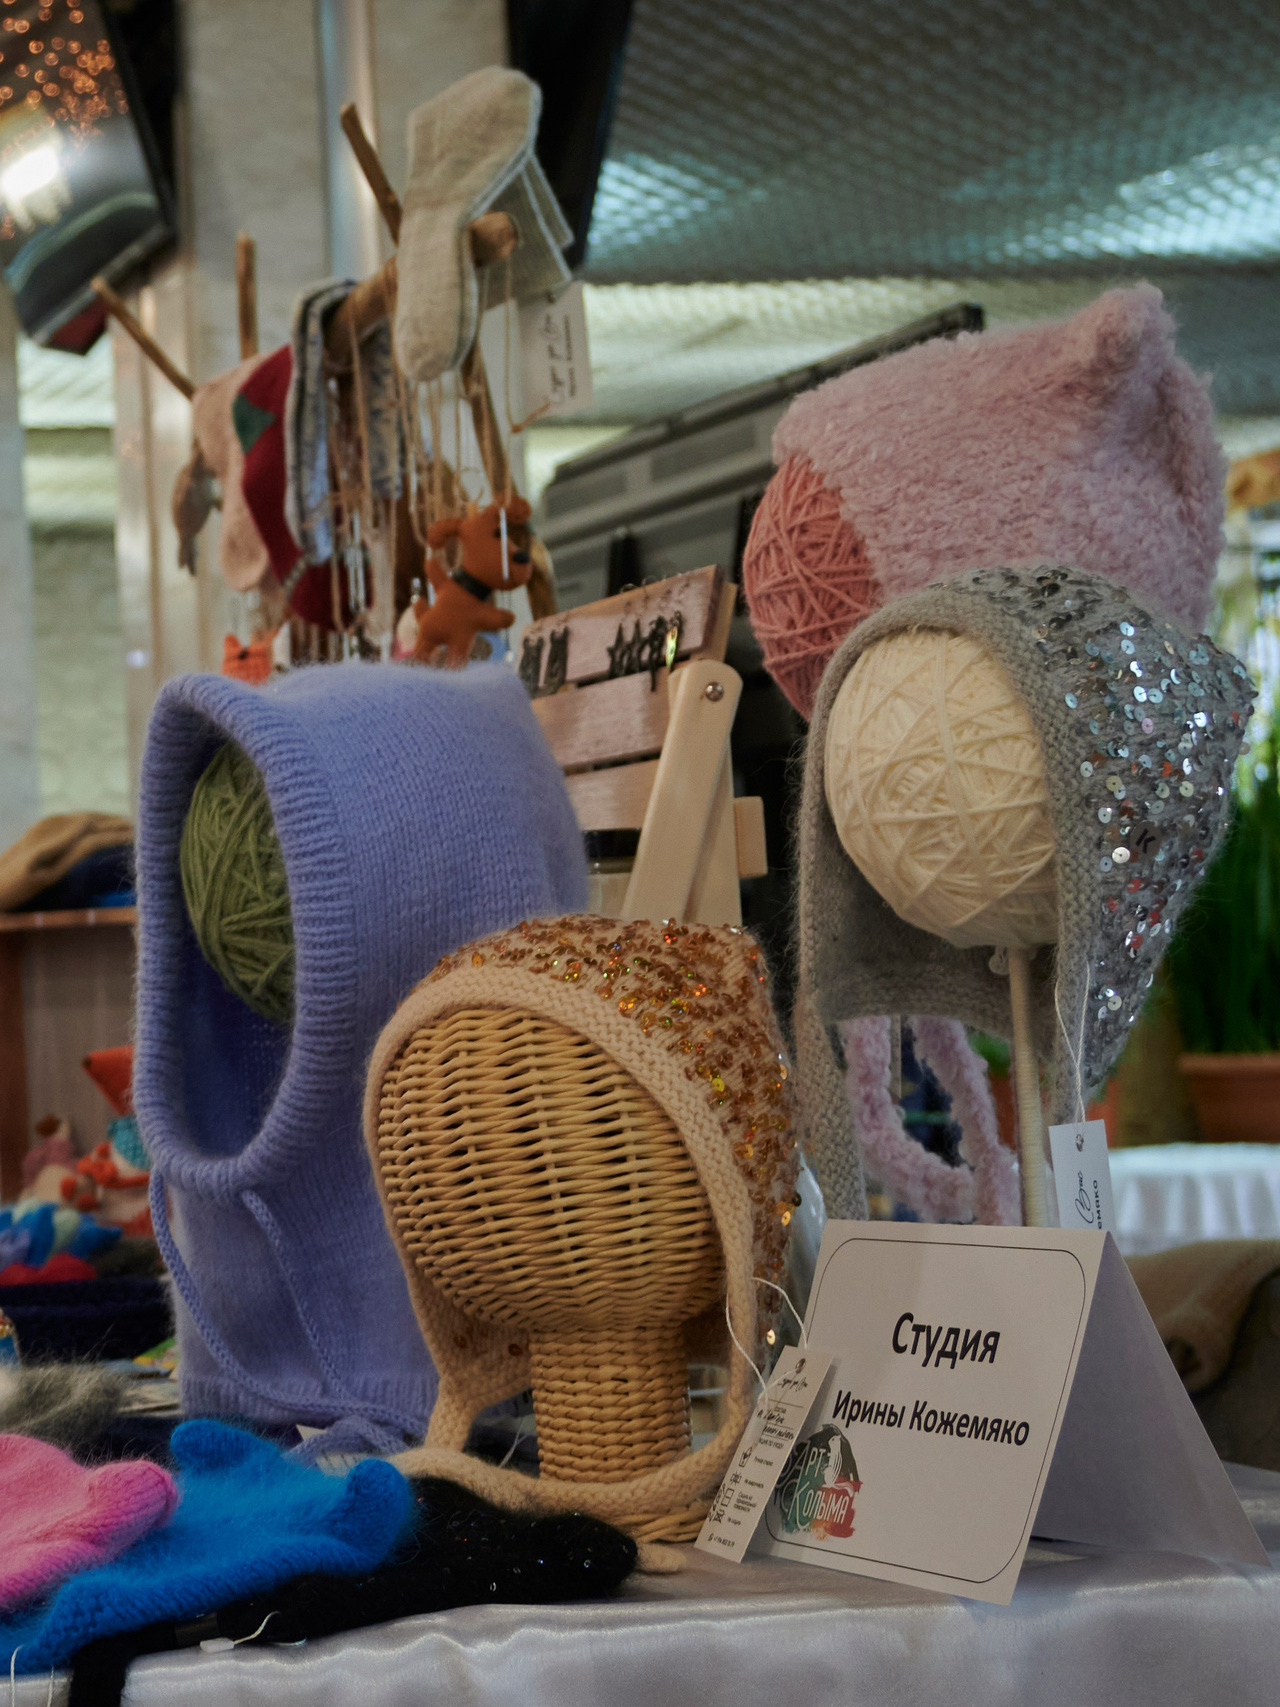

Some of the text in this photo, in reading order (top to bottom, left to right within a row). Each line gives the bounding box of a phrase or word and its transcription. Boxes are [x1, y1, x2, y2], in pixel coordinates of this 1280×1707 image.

[892, 1312, 1001, 1369] Студия
[832, 1389, 906, 1428] Ирины
[908, 1400, 1030, 1446] Кожемяко
